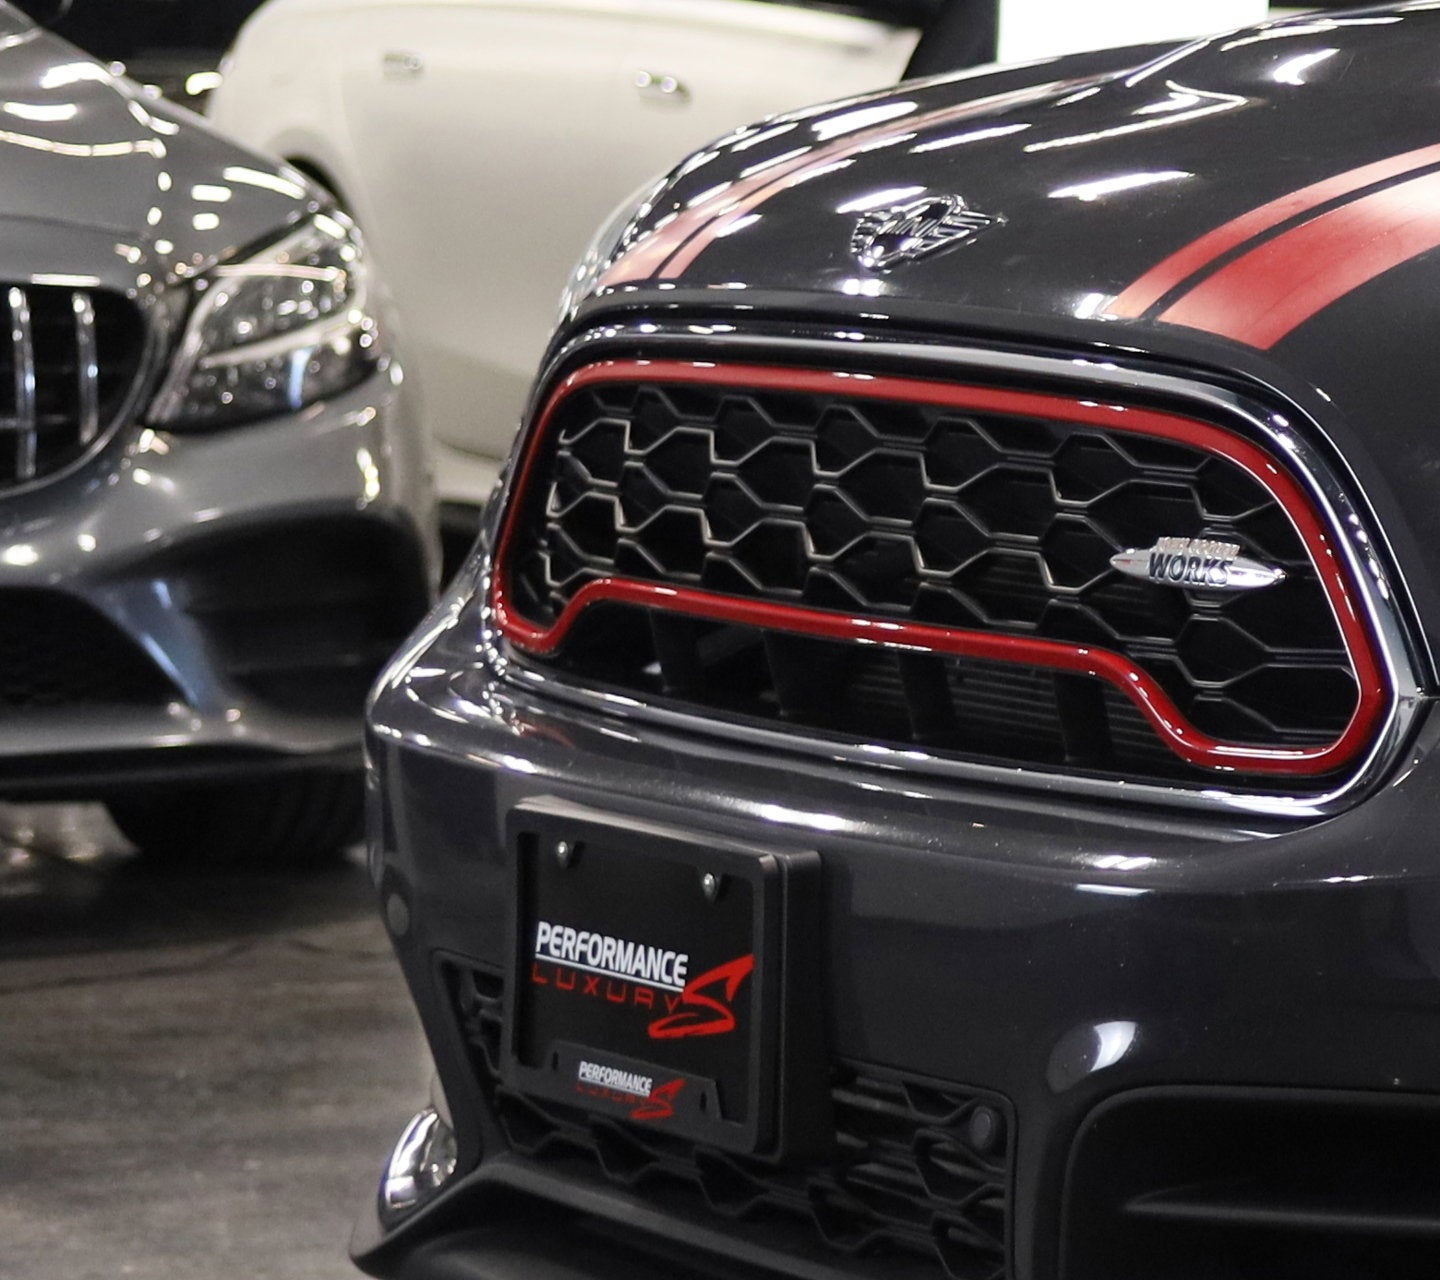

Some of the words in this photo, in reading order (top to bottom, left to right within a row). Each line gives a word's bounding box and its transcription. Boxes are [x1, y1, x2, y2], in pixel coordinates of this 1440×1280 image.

[1149, 552, 1234, 586] WORKS
[535, 920, 689, 987] PERFORMANCE
[531, 963, 683, 1013] LUXURY
[578, 1060, 653, 1094] PERFORMANCE
